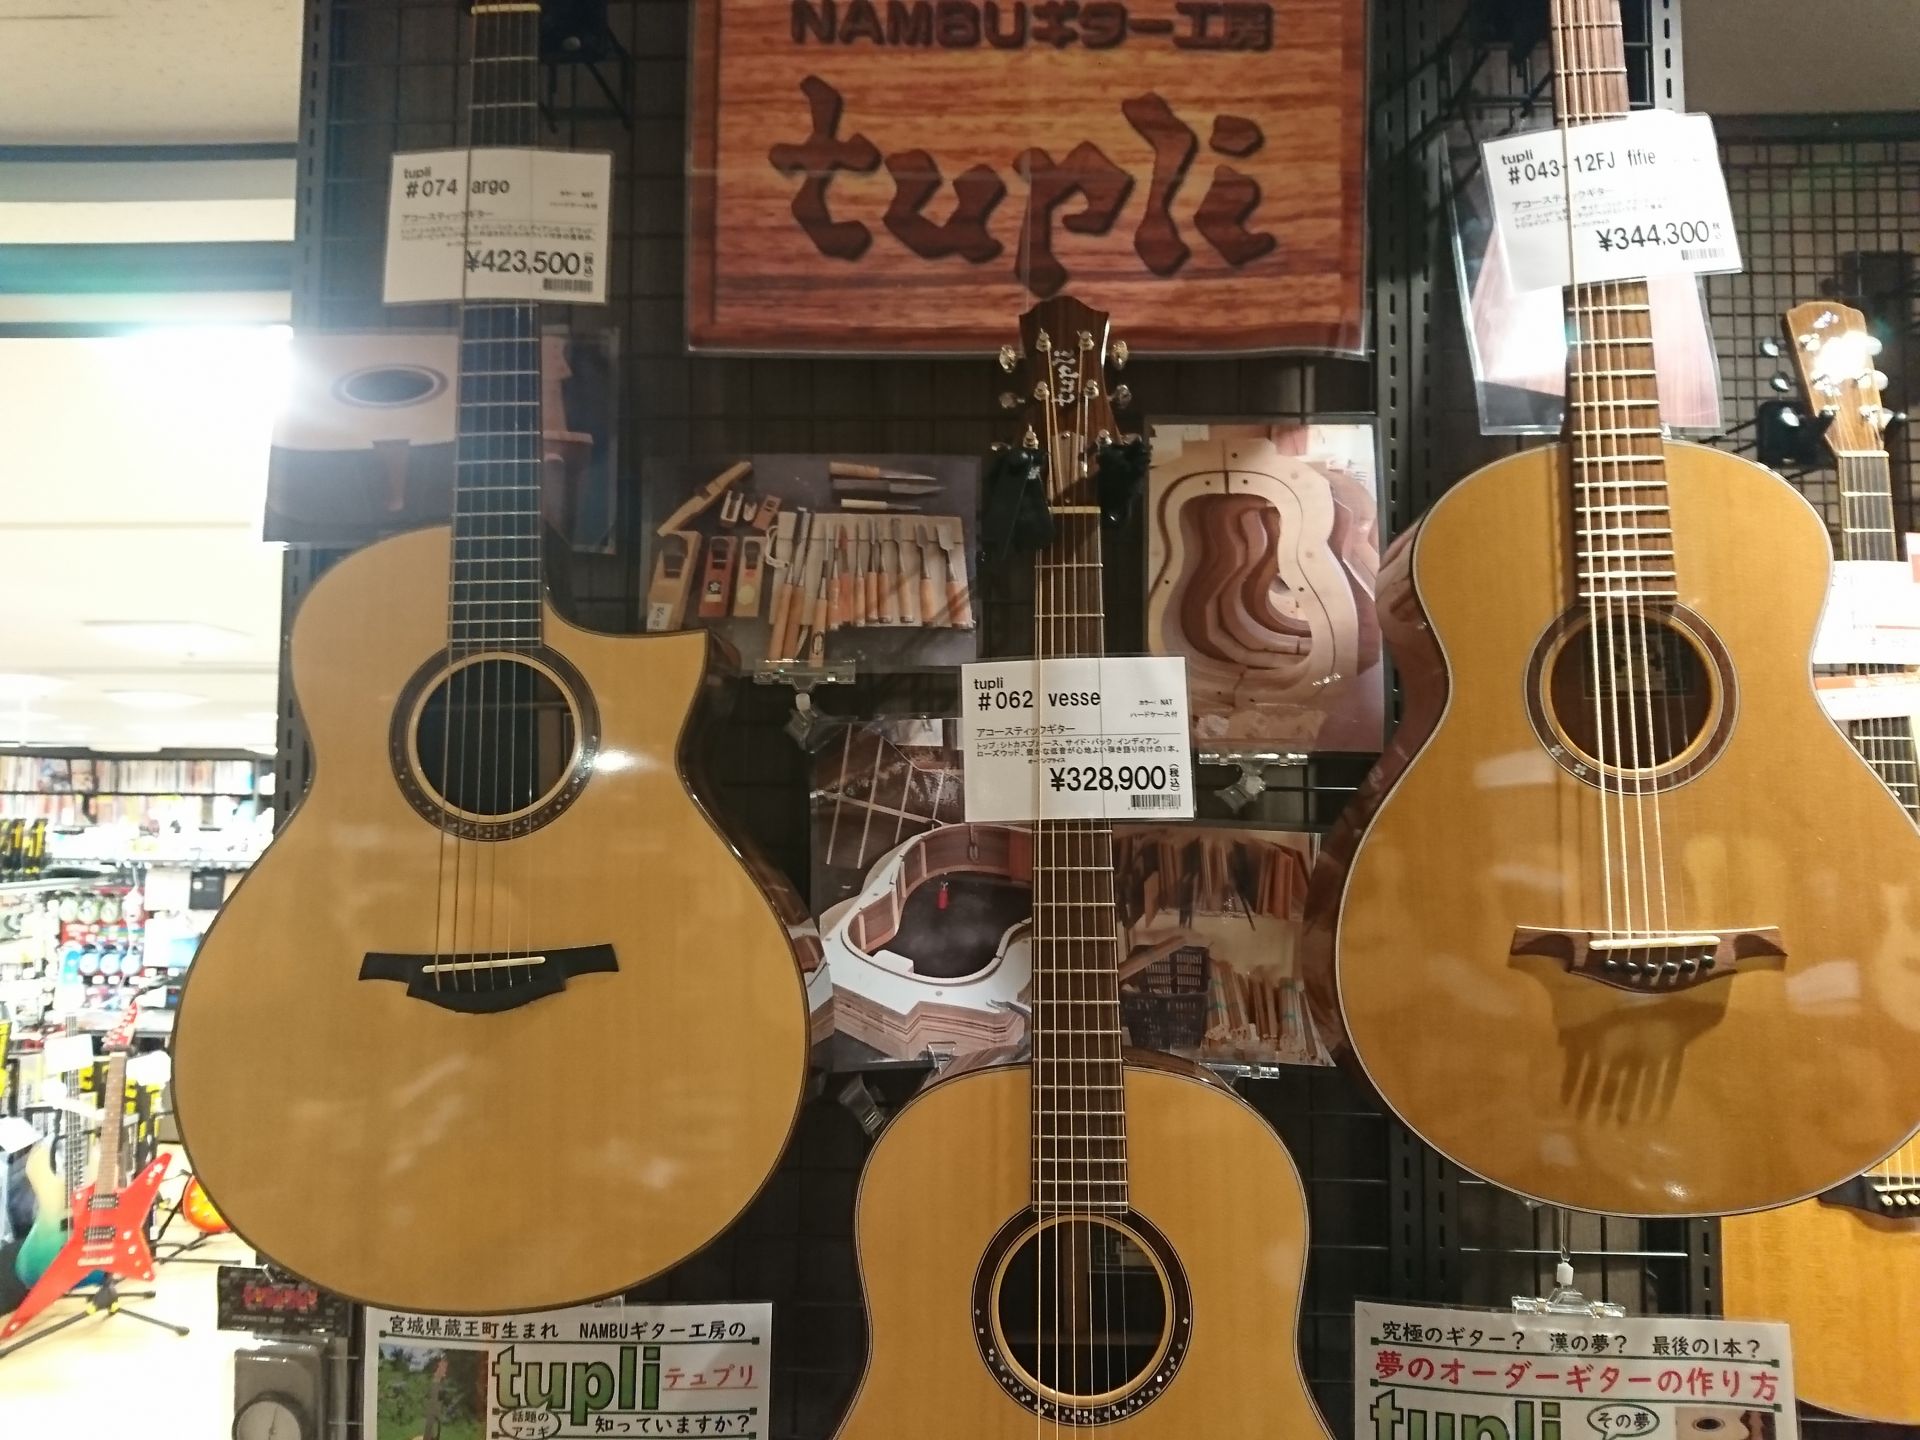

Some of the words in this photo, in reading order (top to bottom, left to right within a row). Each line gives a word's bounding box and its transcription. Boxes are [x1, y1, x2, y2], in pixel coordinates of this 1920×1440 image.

[790, 0, 1274, 51] NAMBUギター工房
[1501, 149, 1534, 166] tupli
[404, 167, 431, 179] tupli
[406, 179, 458, 198] #074
[471, 178, 510, 195] argo
[768, 74, 1276, 298] tupli
[1596, 220, 1709, 252] ¥344,300
[466, 250, 580, 275] ¥423,500
[974, 677, 1004, 690] tupli
[978, 690, 1034, 711] #062
[1048, 692, 1101, 707] vesse
[976, 724, 1076, 738] アコースティックギター
[1050, 766, 1166, 792] ¥328,900
[389, 1314, 560, 1339] 宮城県蔵王町生まれ
[579, 1320, 746, 1340] NAMBUギター工房の
[1383, 1320, 1525, 1350] 究極のギター?
[492, 1344, 661, 1427] tupli
[664, 1364, 753, 1387] テュプリ
[1375, 1350, 1780, 1402] 夢のオーダーギターの作り方
[511, 1410, 549, 1424] 話題の
[1598, 1411, 1650, 1431] その夢
[512, 1425, 549, 1438] アコギ
